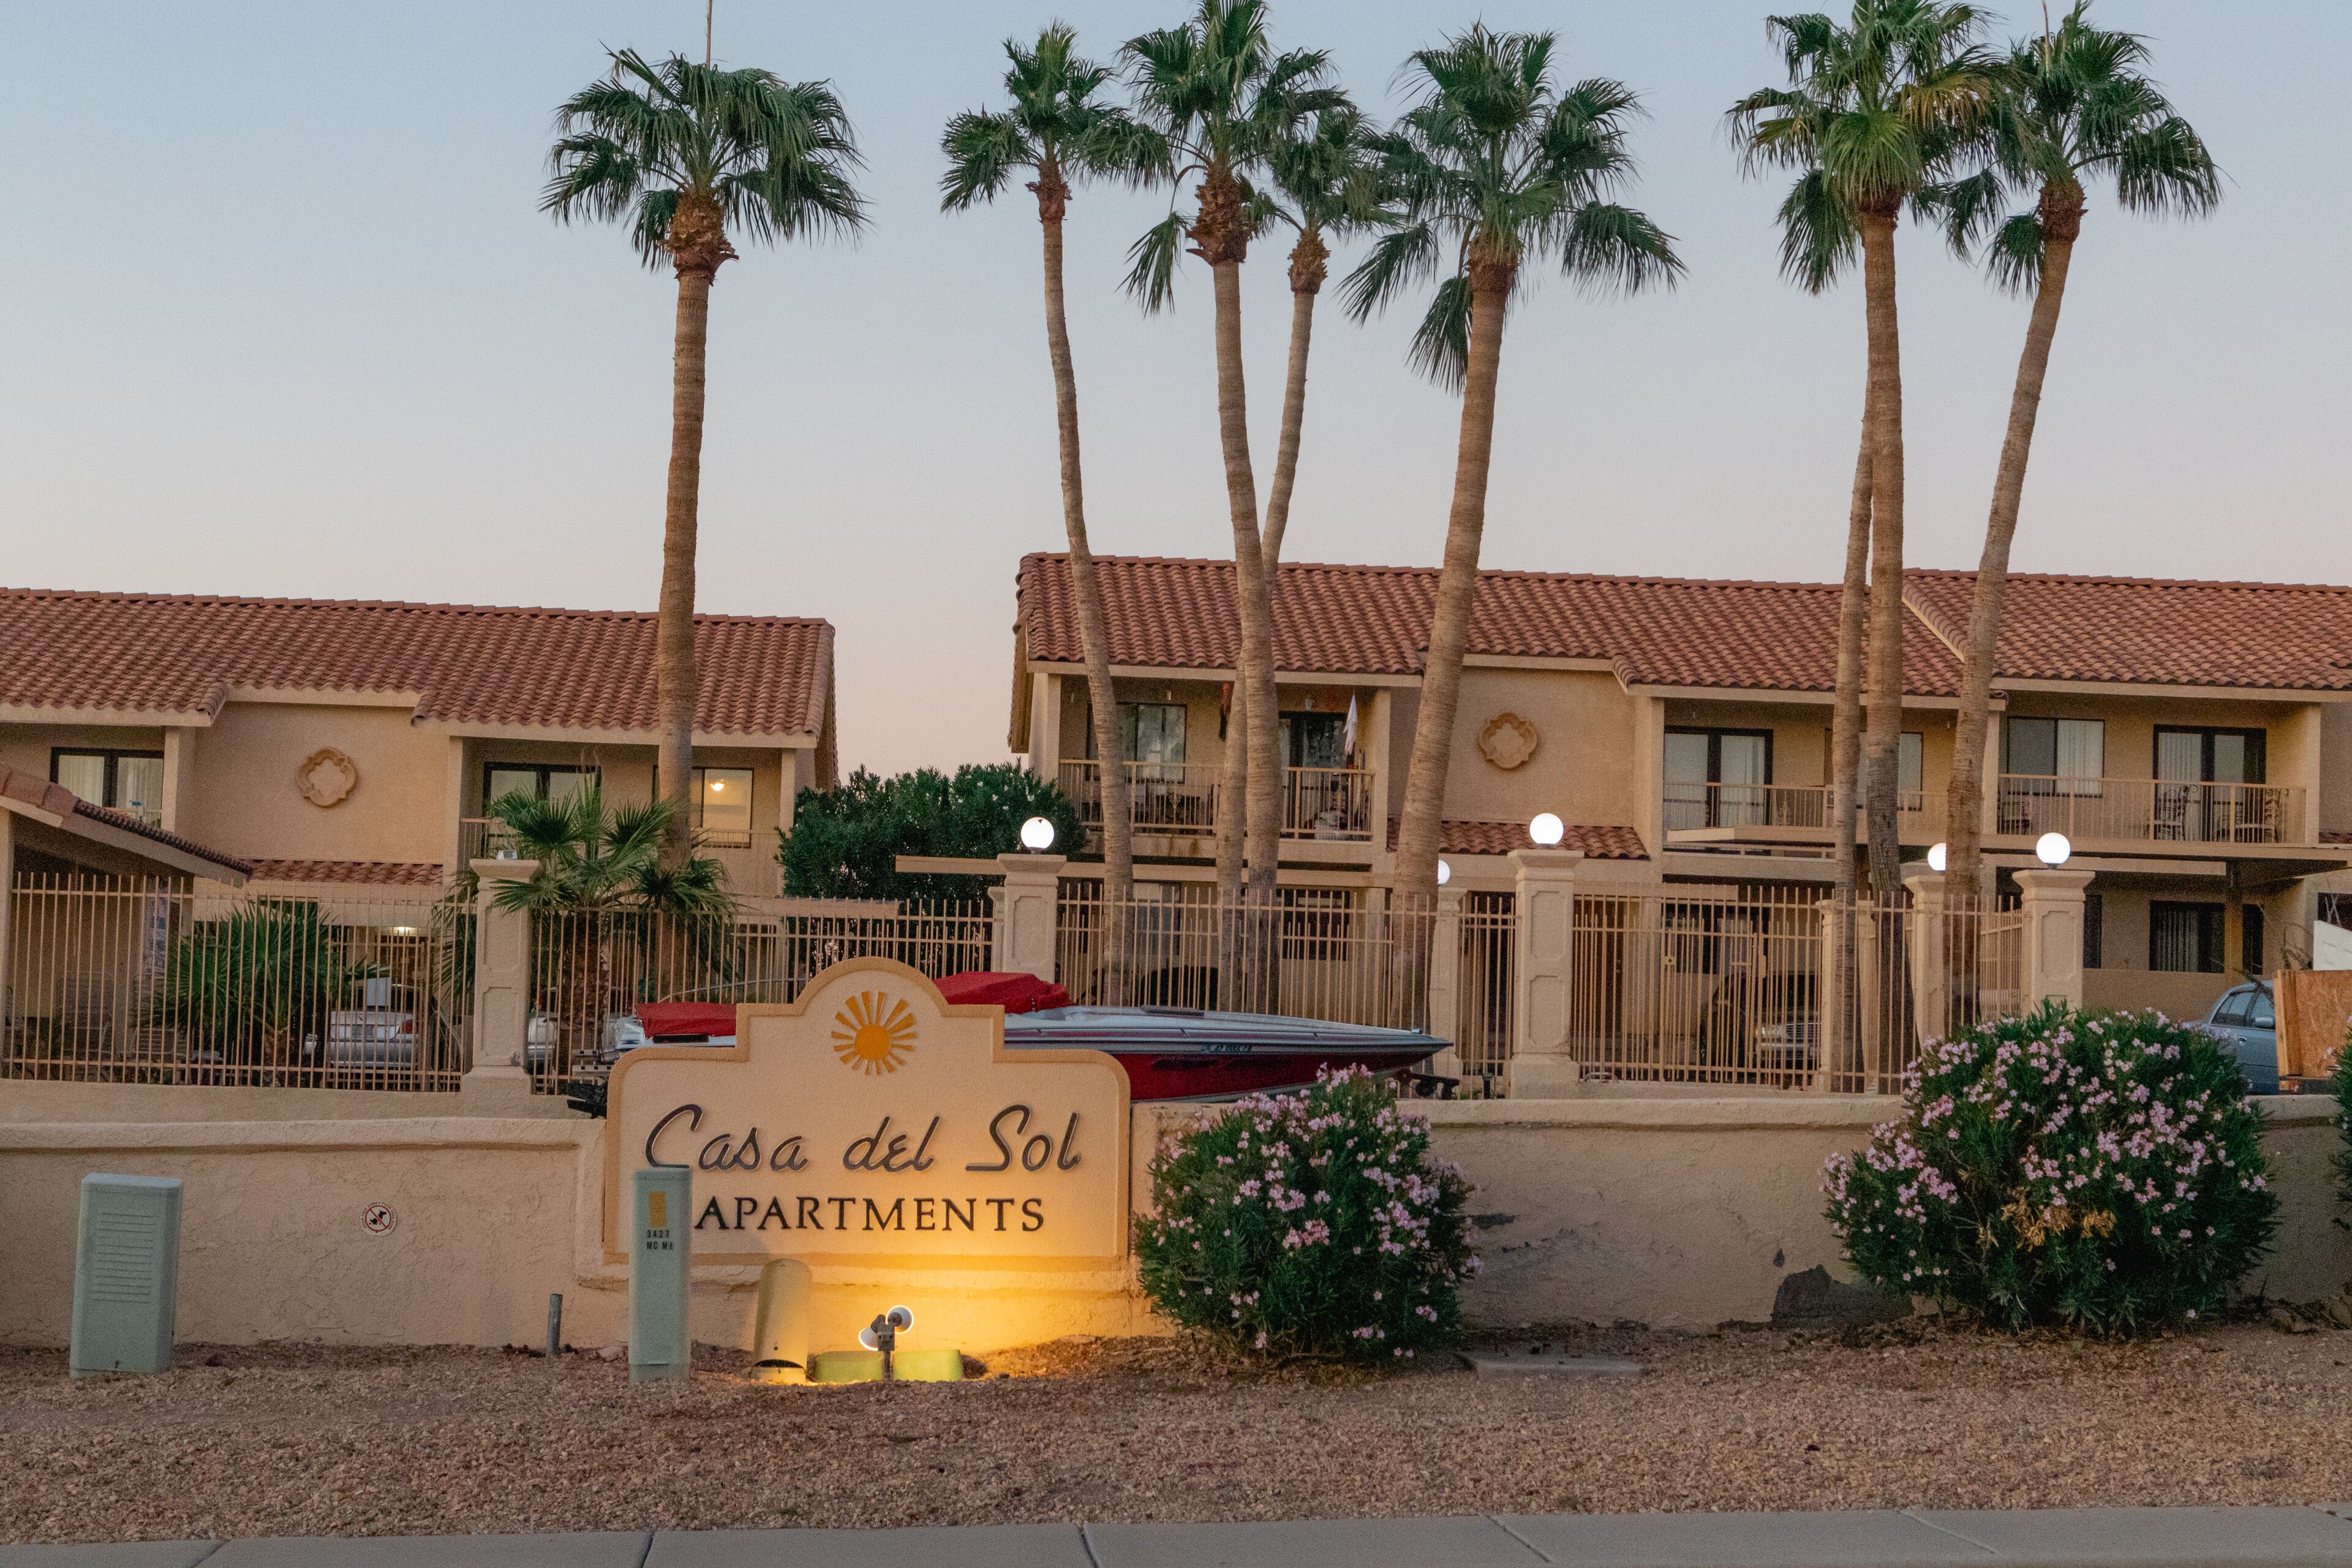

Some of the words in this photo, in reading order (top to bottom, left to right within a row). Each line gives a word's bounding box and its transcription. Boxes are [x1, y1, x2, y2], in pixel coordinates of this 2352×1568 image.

[646, 1104, 809, 1170] Casa
[843, 1116, 941, 1172] del
[965, 1104, 1080, 1172] Sol
[694, 1196, 1044, 1232] APARTMENTS
